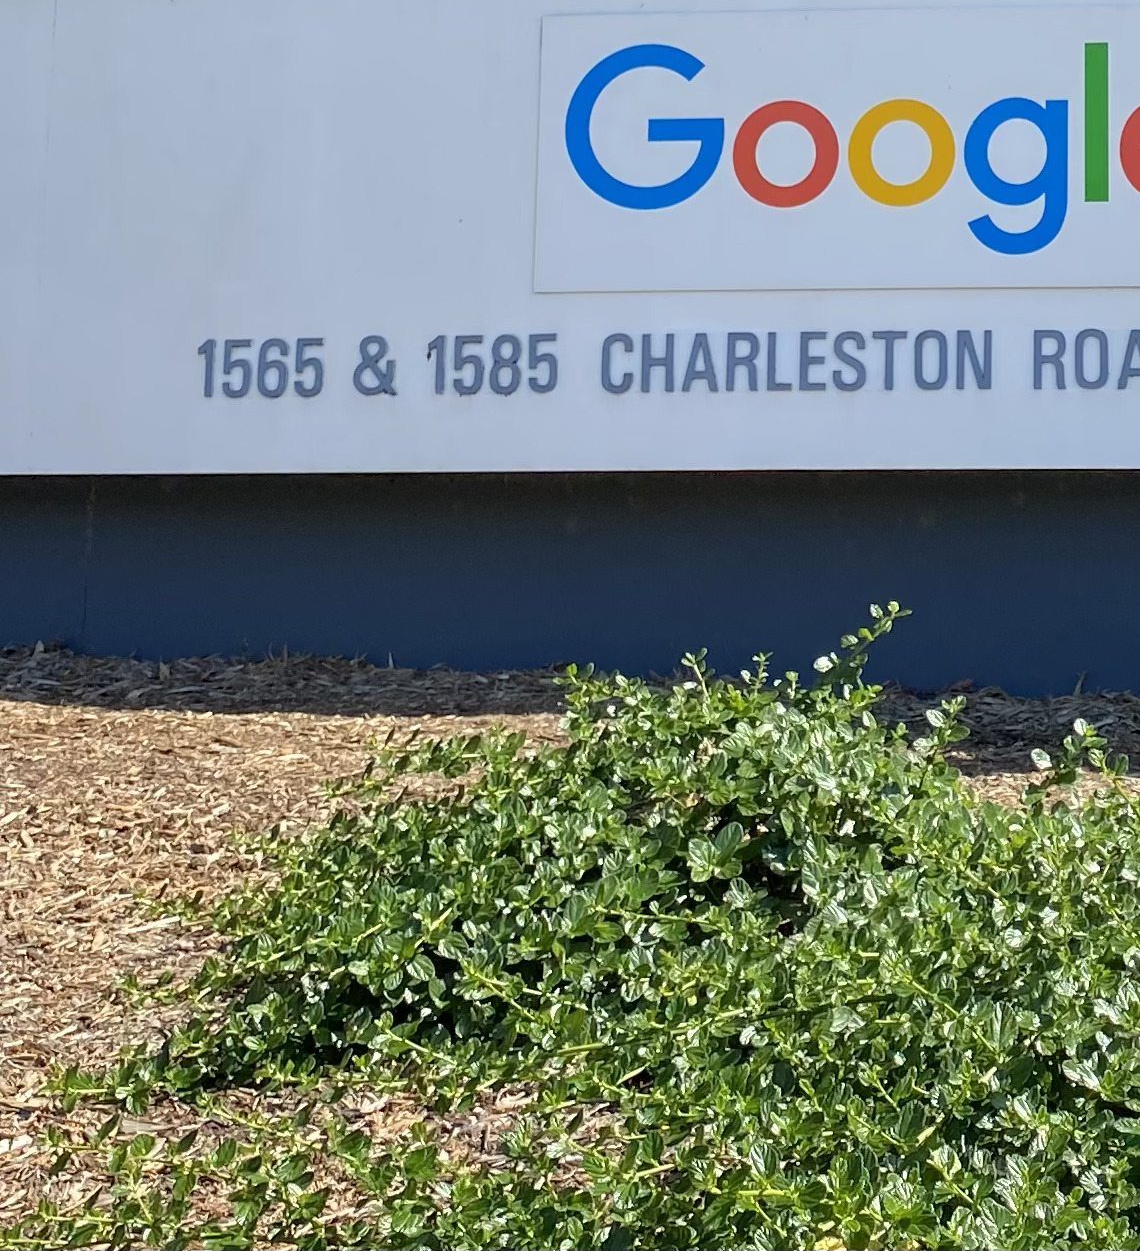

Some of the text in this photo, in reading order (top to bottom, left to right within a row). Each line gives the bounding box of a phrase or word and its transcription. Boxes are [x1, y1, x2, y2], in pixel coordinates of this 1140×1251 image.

[197, 337, 326, 401] 1565
[353, 335, 399, 398] &
[426, 333, 559, 399] 1585
[601, 330, 993, 397] CHARLESTON
